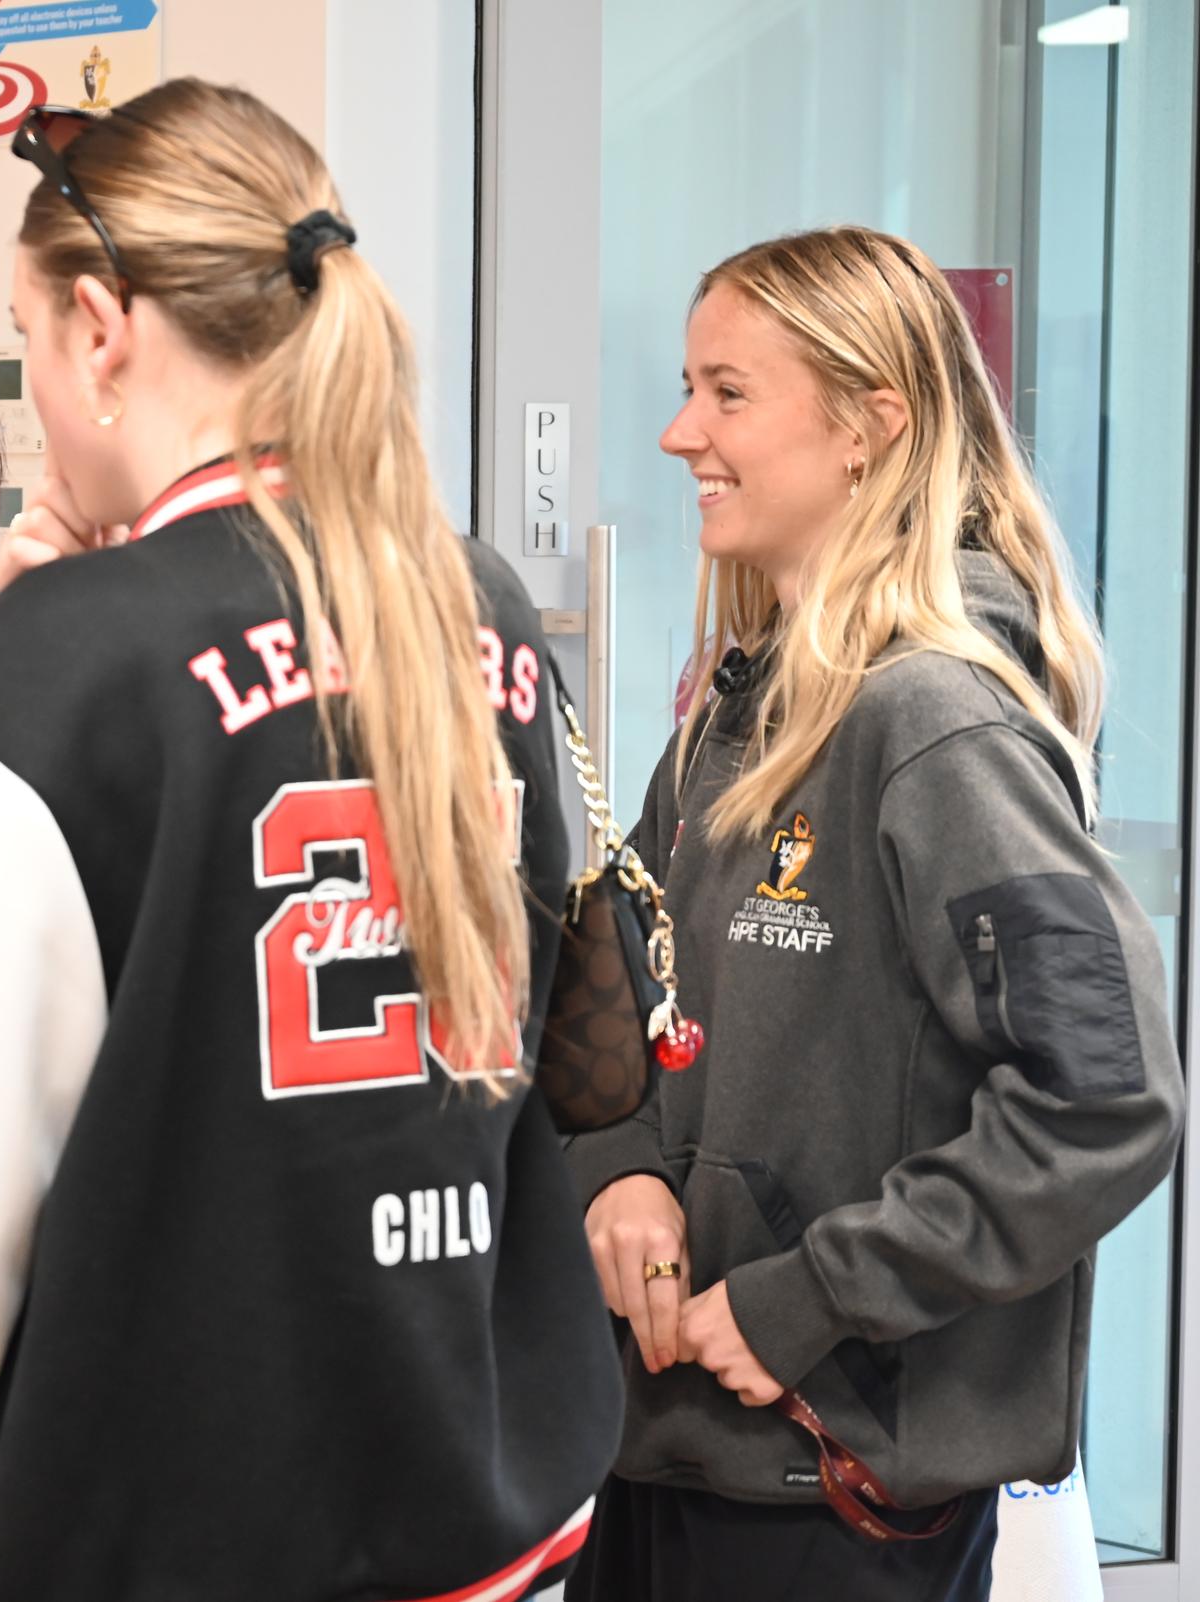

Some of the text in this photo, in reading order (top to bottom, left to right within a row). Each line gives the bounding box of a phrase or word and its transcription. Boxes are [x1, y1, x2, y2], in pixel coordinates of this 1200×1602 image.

[30, 9, 65, 21] electronic
[66, 6, 93, 18] devices
[535, 411, 557, 549] PUSH
[188, 617, 539, 735] LEARS
[744, 897, 820, 921] ST GEORGE'S
[728, 920, 834, 953] HPE STAFF
